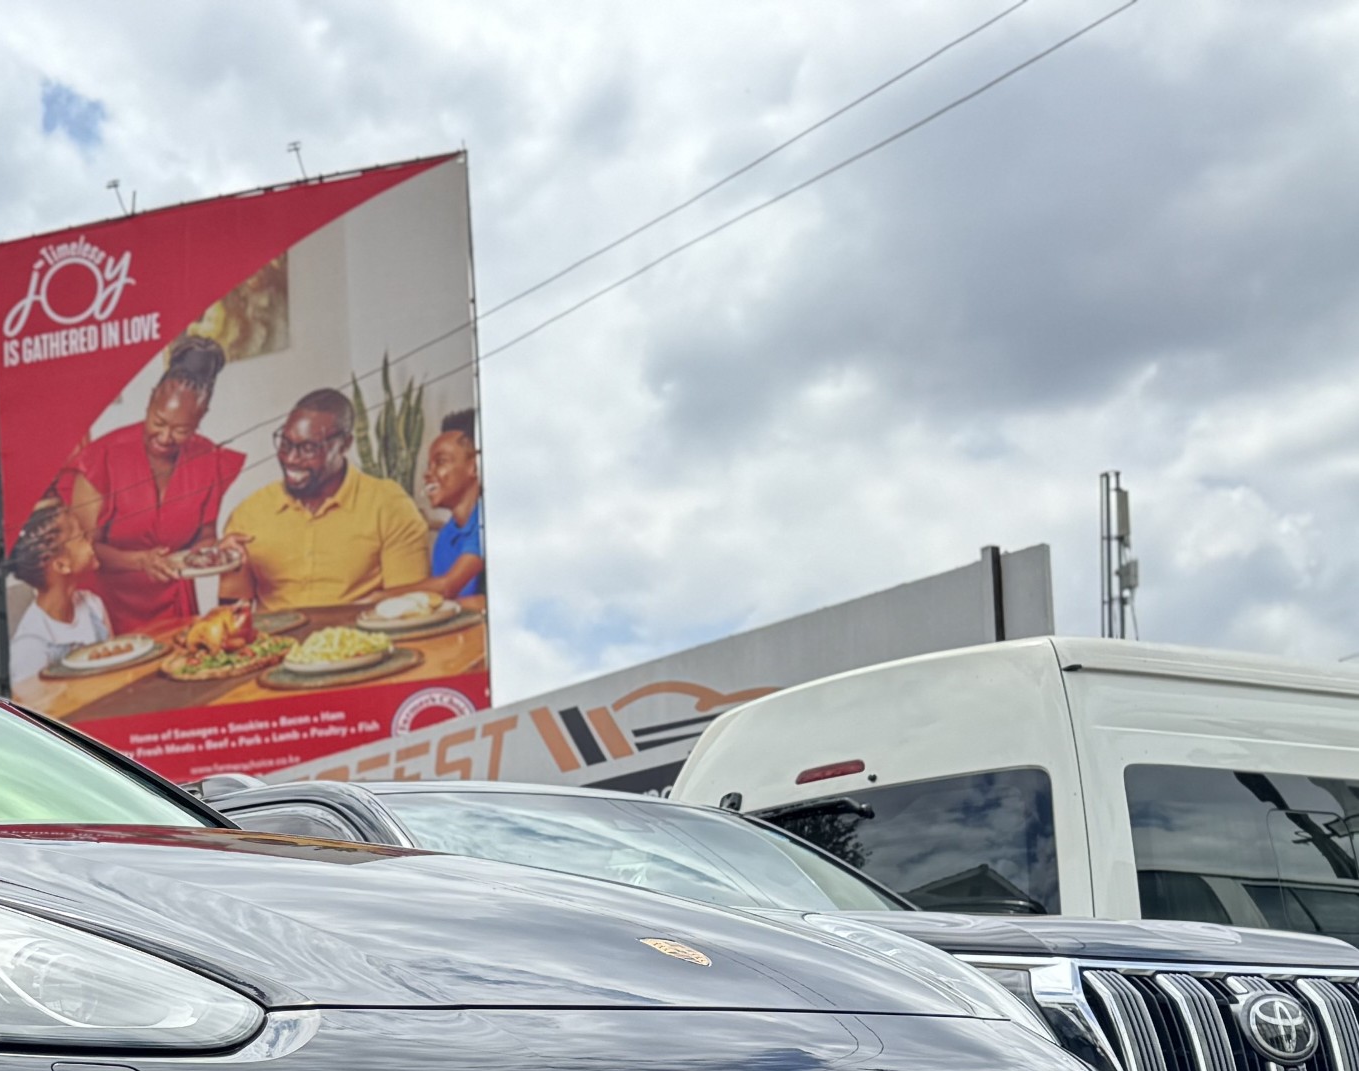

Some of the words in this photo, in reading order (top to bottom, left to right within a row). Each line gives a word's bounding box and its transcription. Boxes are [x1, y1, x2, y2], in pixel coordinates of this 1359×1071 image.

[3, 340, 20, 368] IS
[22, 325, 99, 364] GATHERED
[101, 320, 120, 350] IN
[123, 312, 161, 345] LOVE
[129, 733, 159, 745] Home
[160, 728, 172, 741] of
[173, 726, 219, 740] Sausages
[228, 719, 270, 734] Smokies
[279, 715, 311, 727] Bacon
[320, 710, 346, 722] Ham
[136, 744, 163, 759] Fresh
[163, 742, 196, 755] Meats
[204, 736, 229, 751] Beef
[238, 733, 261, 747] Pork
[271, 729, 300, 743] Lamb
[309, 724, 348, 739] Poultry
[357, 719, 380, 733] Fish
